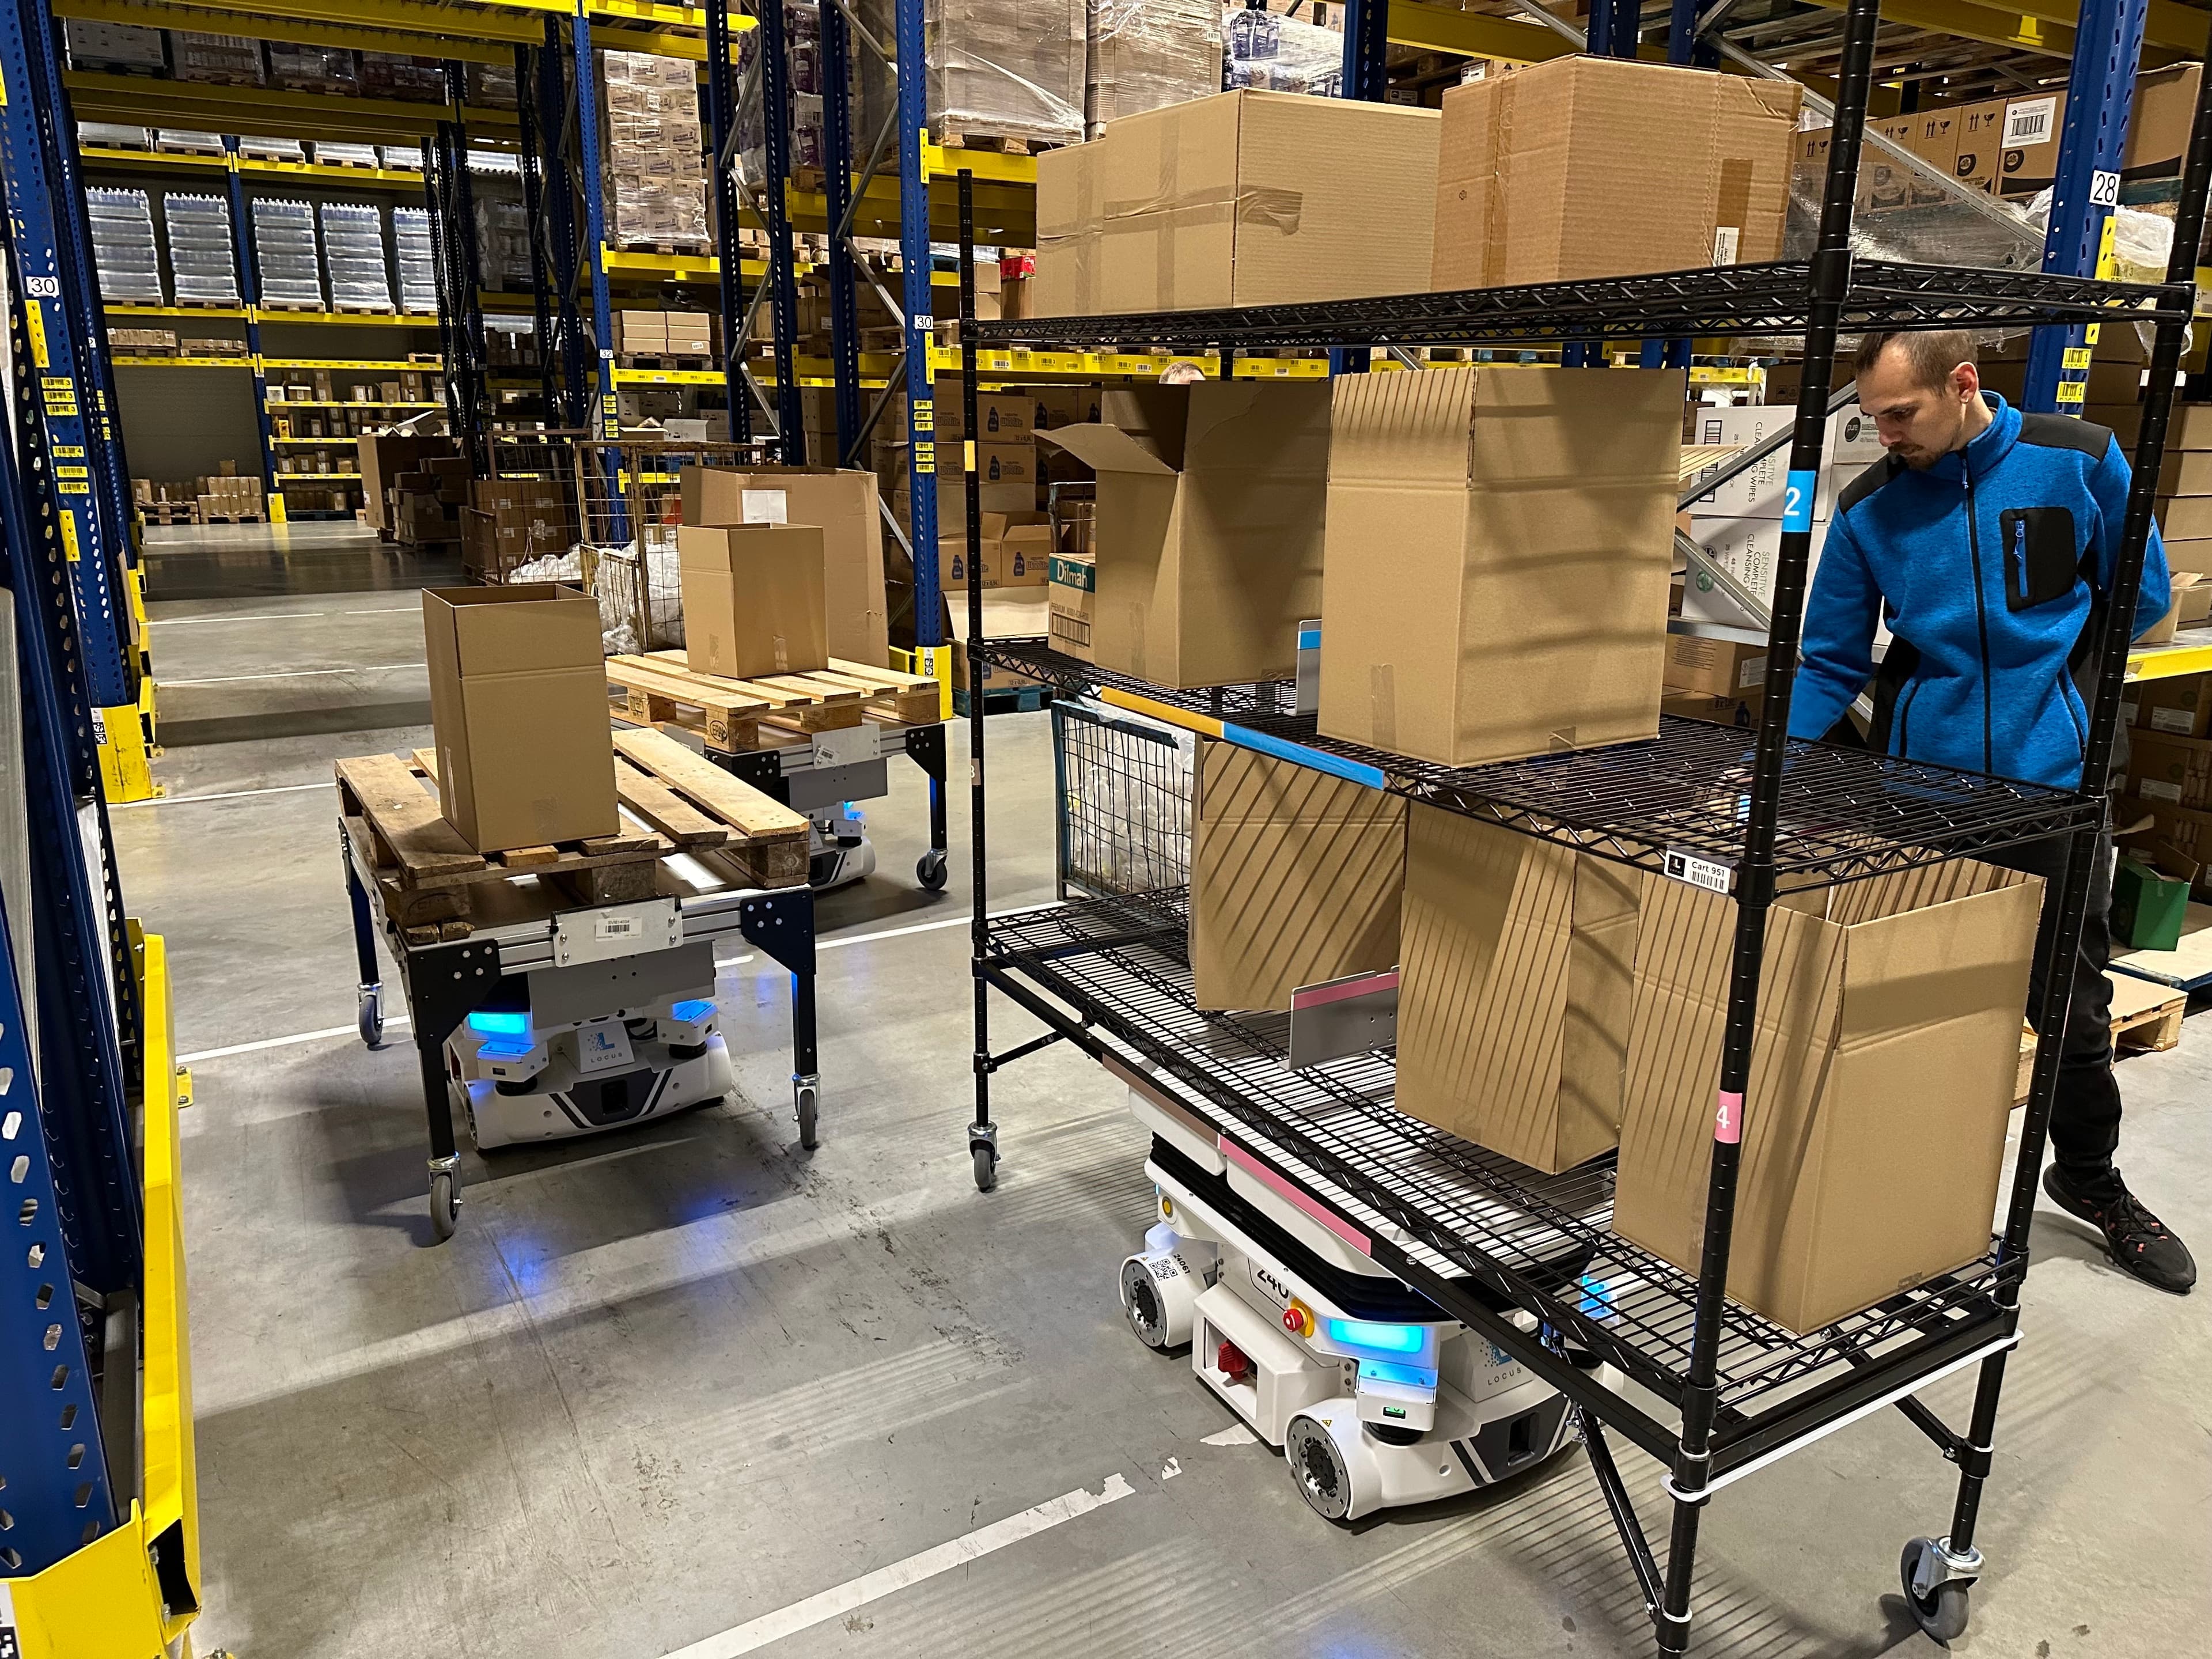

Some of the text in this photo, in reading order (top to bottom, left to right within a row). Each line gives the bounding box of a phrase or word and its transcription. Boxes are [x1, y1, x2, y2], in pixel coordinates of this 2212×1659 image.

[2093, 173, 2116, 203] 28
[31, 278, 55, 293] 30
[917, 316, 932, 328] 30
[2084, 353, 2088, 363] 1
[2078, 385, 2082, 396] 1
[1847, 424, 1859, 433] pure
[1758, 459, 1767, 485] MPLETE
[1766, 450, 1776, 487] NSITIVE
[1748, 476, 1756, 503] WIPES
[1783, 486, 1801, 516] 2
[1730, 557, 1736, 565] 48
[1743, 533, 1755, 584] CLEANSING
[1056, 560, 1088, 589] Dilmah
[1750, 551, 1761, 596] COMPLETE
[1758, 551, 1770, 598] SENSITIVE
[1692, 861, 1709, 873] Cart
[1711, 867, 1725, 877] 951
[590, 1052, 623, 1063] LOCUS
[1716, 1105, 1730, 1129] 4
[1173, 1253, 1191, 1274] 24061
[1487, 1367, 1521, 1386] LOCUS
